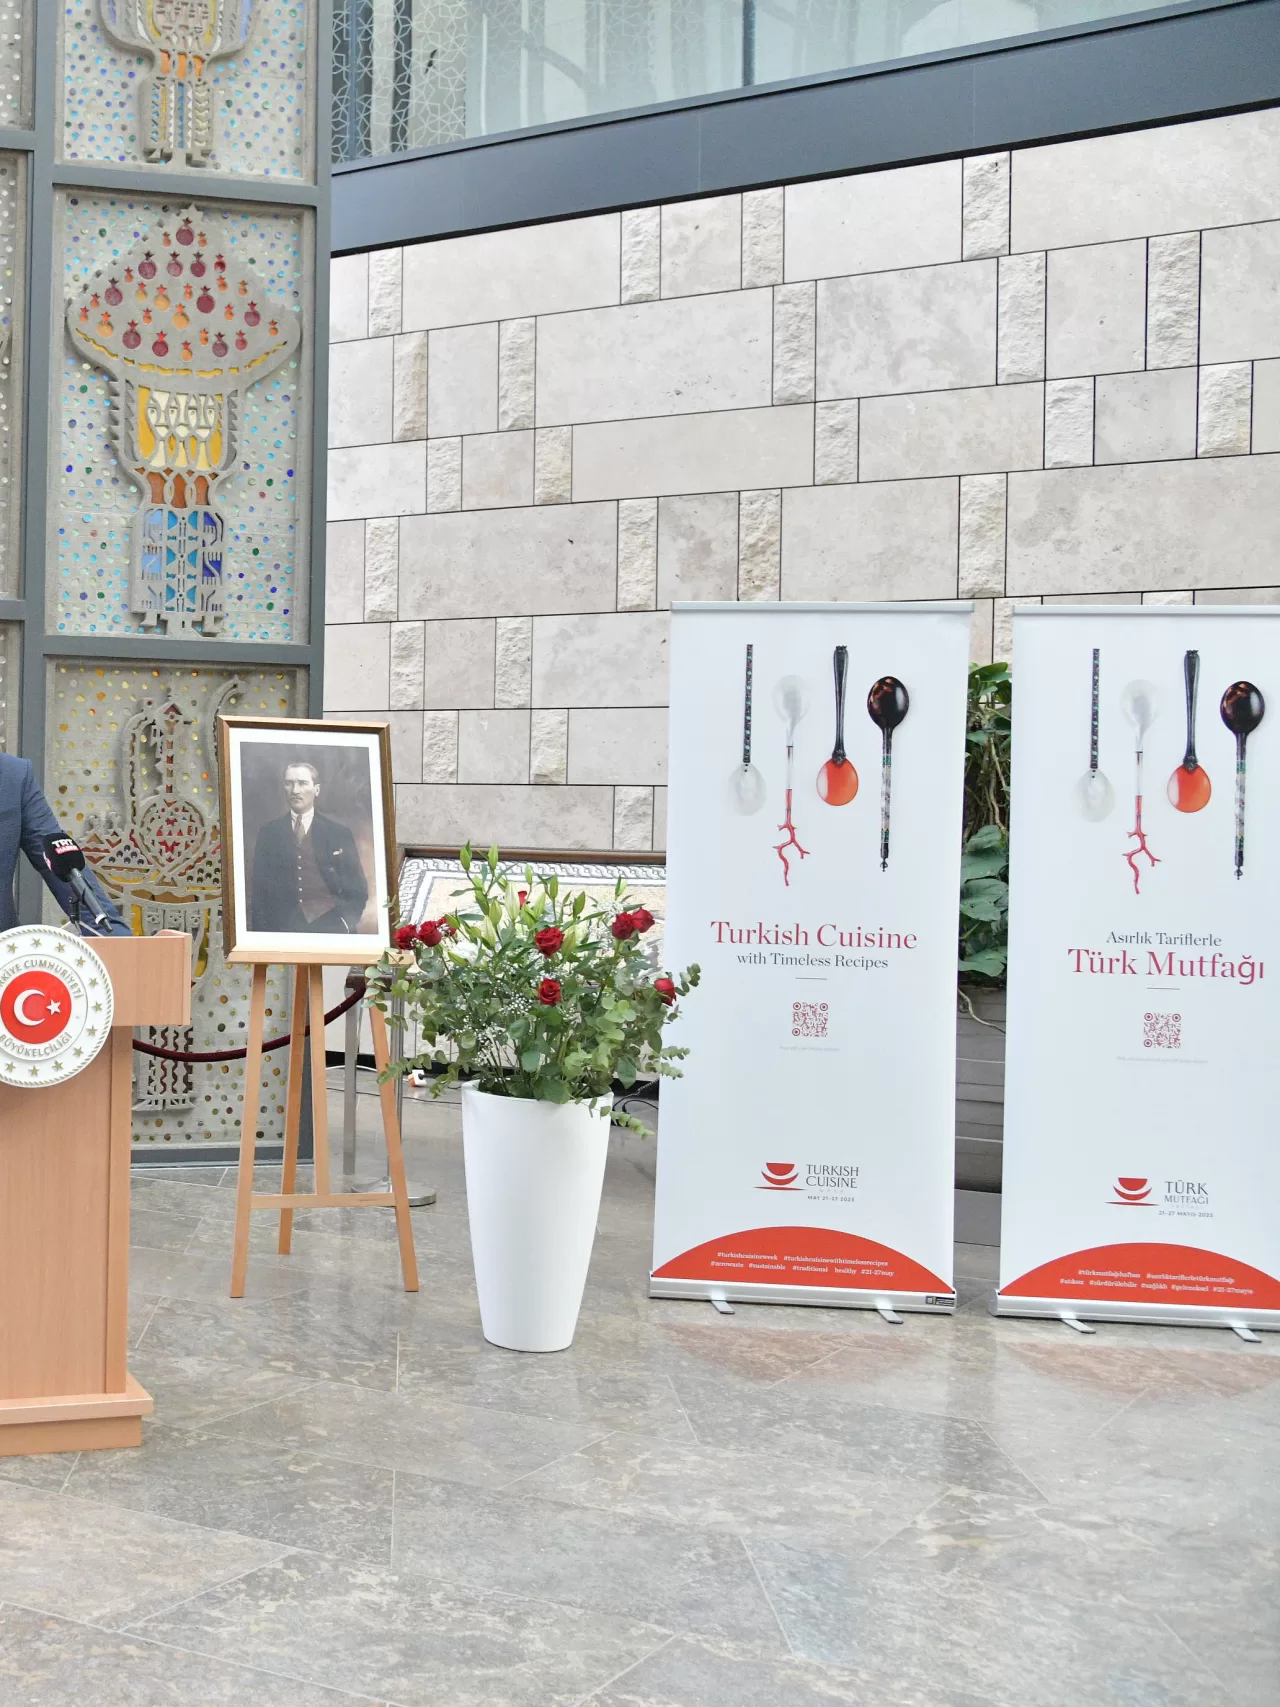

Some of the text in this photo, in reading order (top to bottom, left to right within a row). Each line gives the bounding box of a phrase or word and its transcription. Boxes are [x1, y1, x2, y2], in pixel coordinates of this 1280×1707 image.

[51, 839, 74, 848] TRT
[710, 921, 918, 949] Turkish Cuisine
[1105, 931, 1222, 947] Asırlık Tariflerle
[737, 952, 889, 970] with Timeless Recipes
[1067, 948, 1264, 985] Türk Mutfağı
[23, 959, 84, 999] CUMHURİYETİ
[805, 1164, 859, 1177] TURKISH
[805, 1176, 858, 1189] CUISINE
[1164, 1180, 1209, 1195] TÜRK
